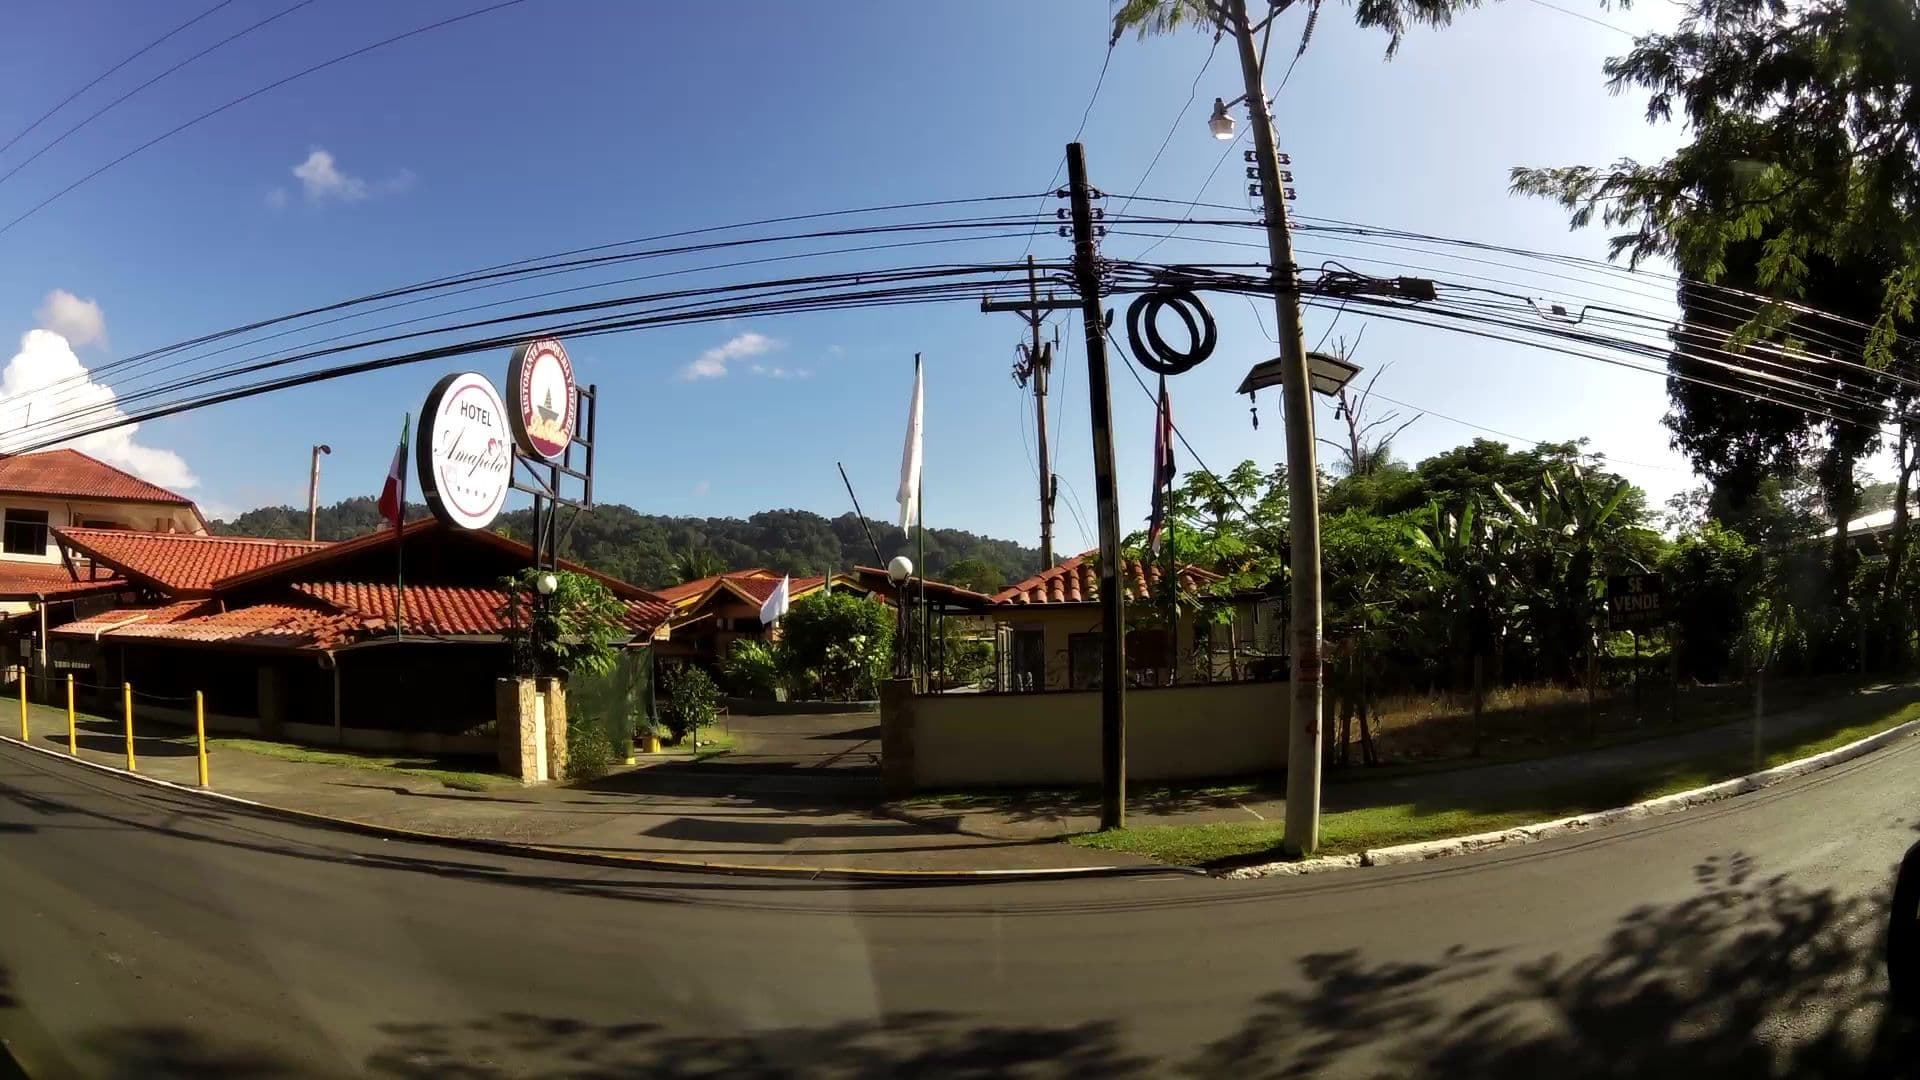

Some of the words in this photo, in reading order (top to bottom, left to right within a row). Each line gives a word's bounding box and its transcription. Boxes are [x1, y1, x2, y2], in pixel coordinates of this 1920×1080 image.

[460, 400, 492, 427] HOTEL
[434, 427, 509, 477] Amapola
[1628, 577, 1643, 593] SE
[1614, 593, 1660, 612] VENDE
